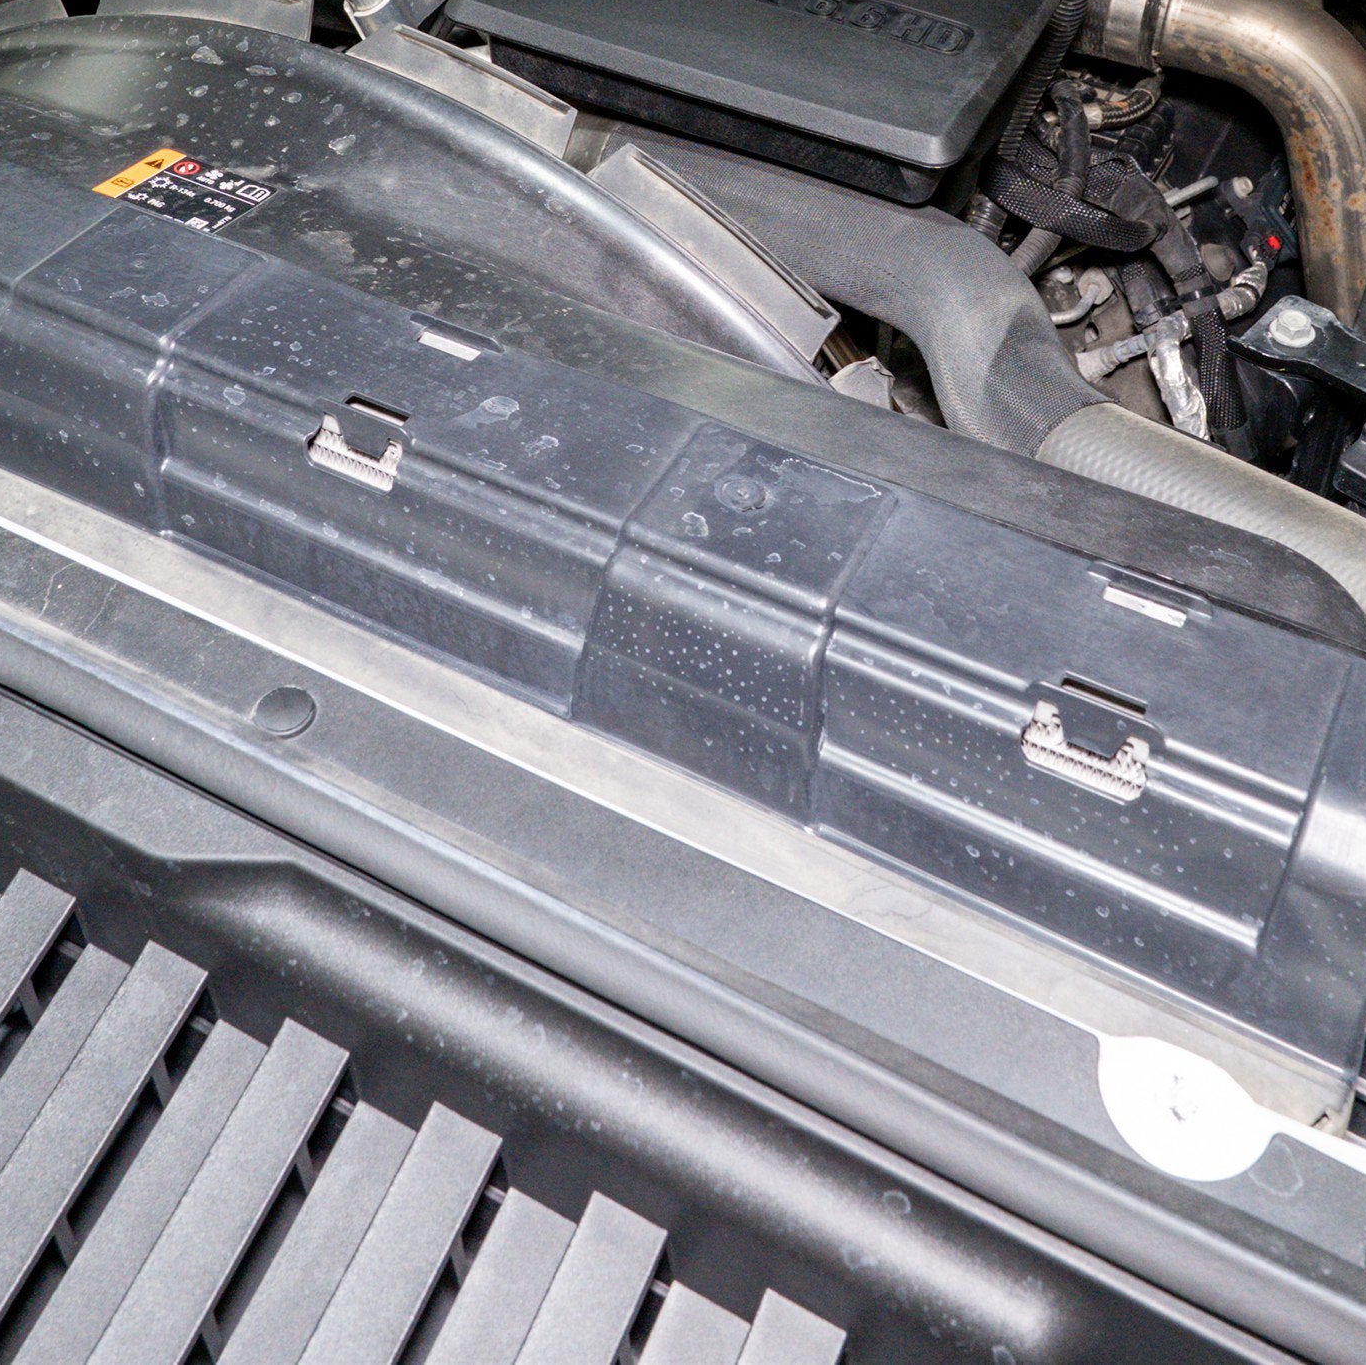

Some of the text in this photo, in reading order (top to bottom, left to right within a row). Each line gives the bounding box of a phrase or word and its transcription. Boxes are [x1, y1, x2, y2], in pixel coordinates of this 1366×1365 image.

[892, 14, 970, 51] HD
[169, 185, 196, 197] R-134a
[147, 198, 166, 208] PAG
